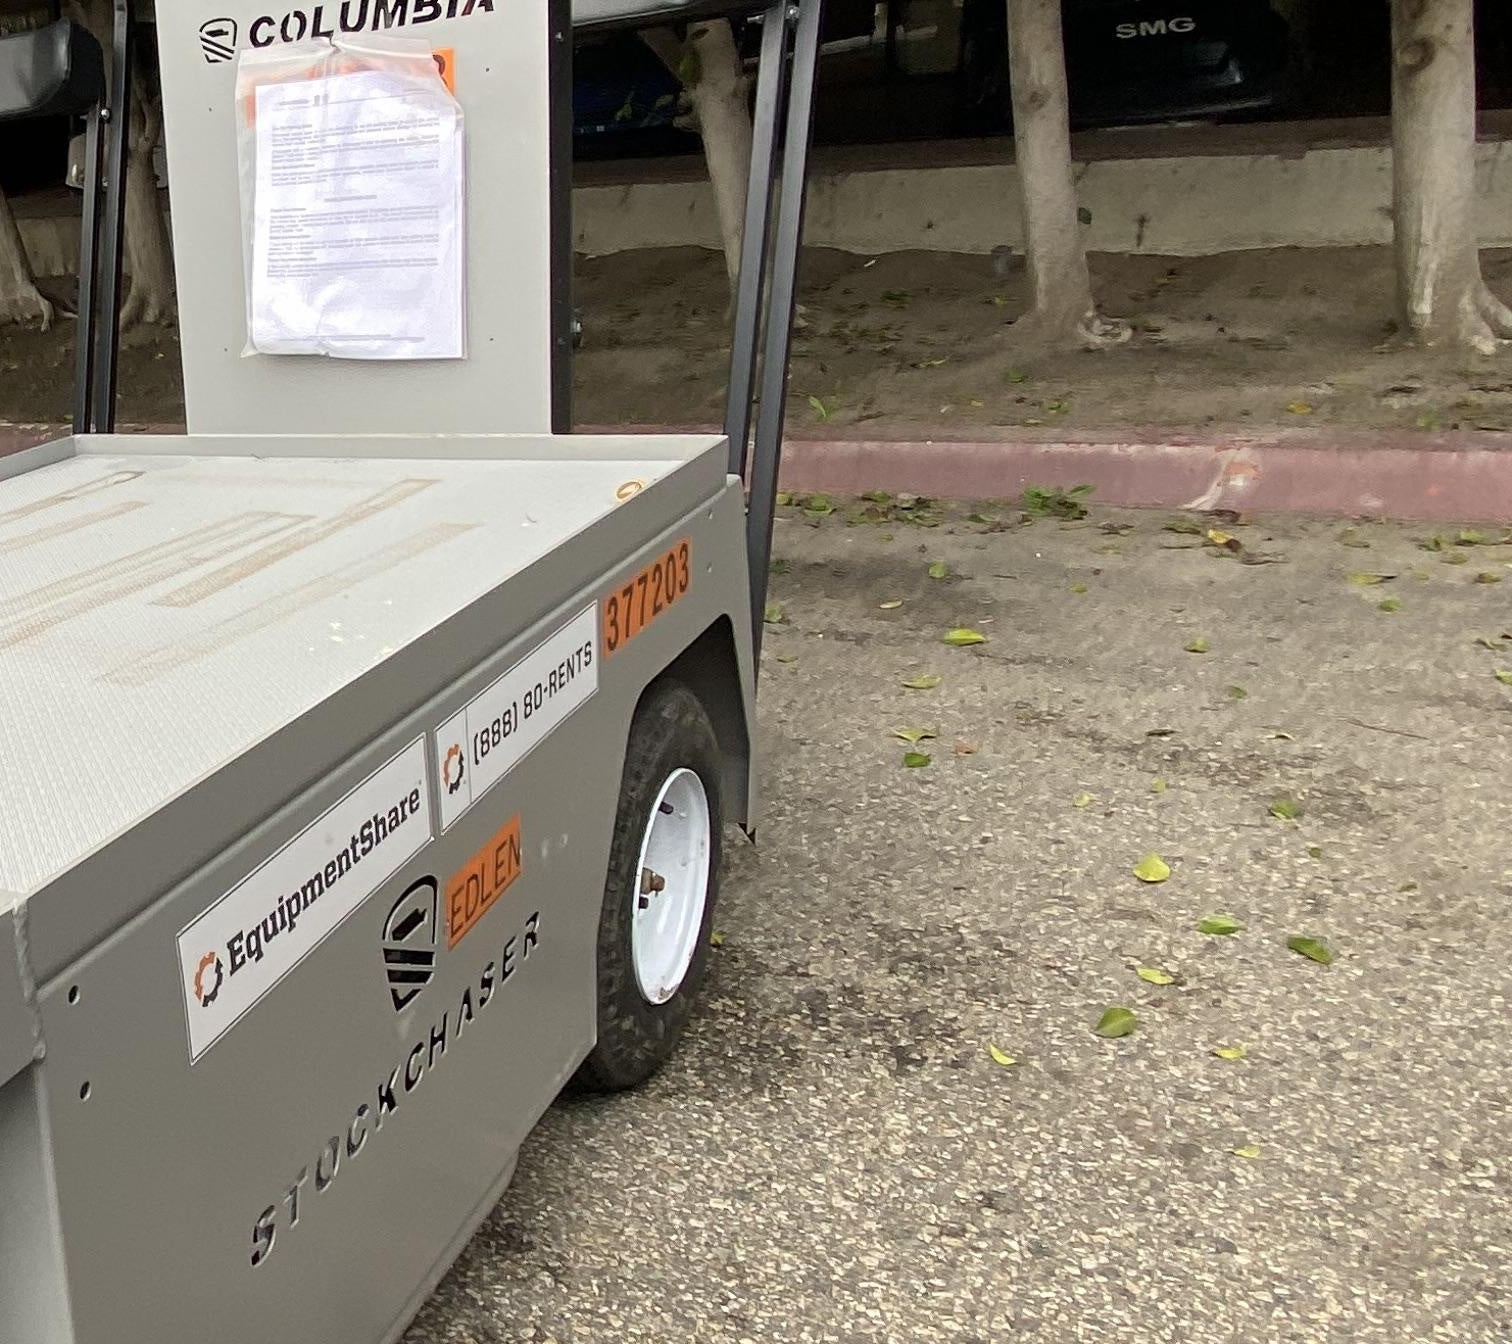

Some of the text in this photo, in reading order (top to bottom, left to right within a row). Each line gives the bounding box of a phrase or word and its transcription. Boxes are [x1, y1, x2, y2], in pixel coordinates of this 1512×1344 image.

[1115, 17, 1197, 39] SMG
[606, 542, 690, 652] 377203
[473, 641, 592, 766] (888) 80-RENTS
[225, 787, 421, 977] EquipmentShare
[448, 834, 522, 938] EDLEN
[250, 910, 541, 1269] STOCKCHASER
